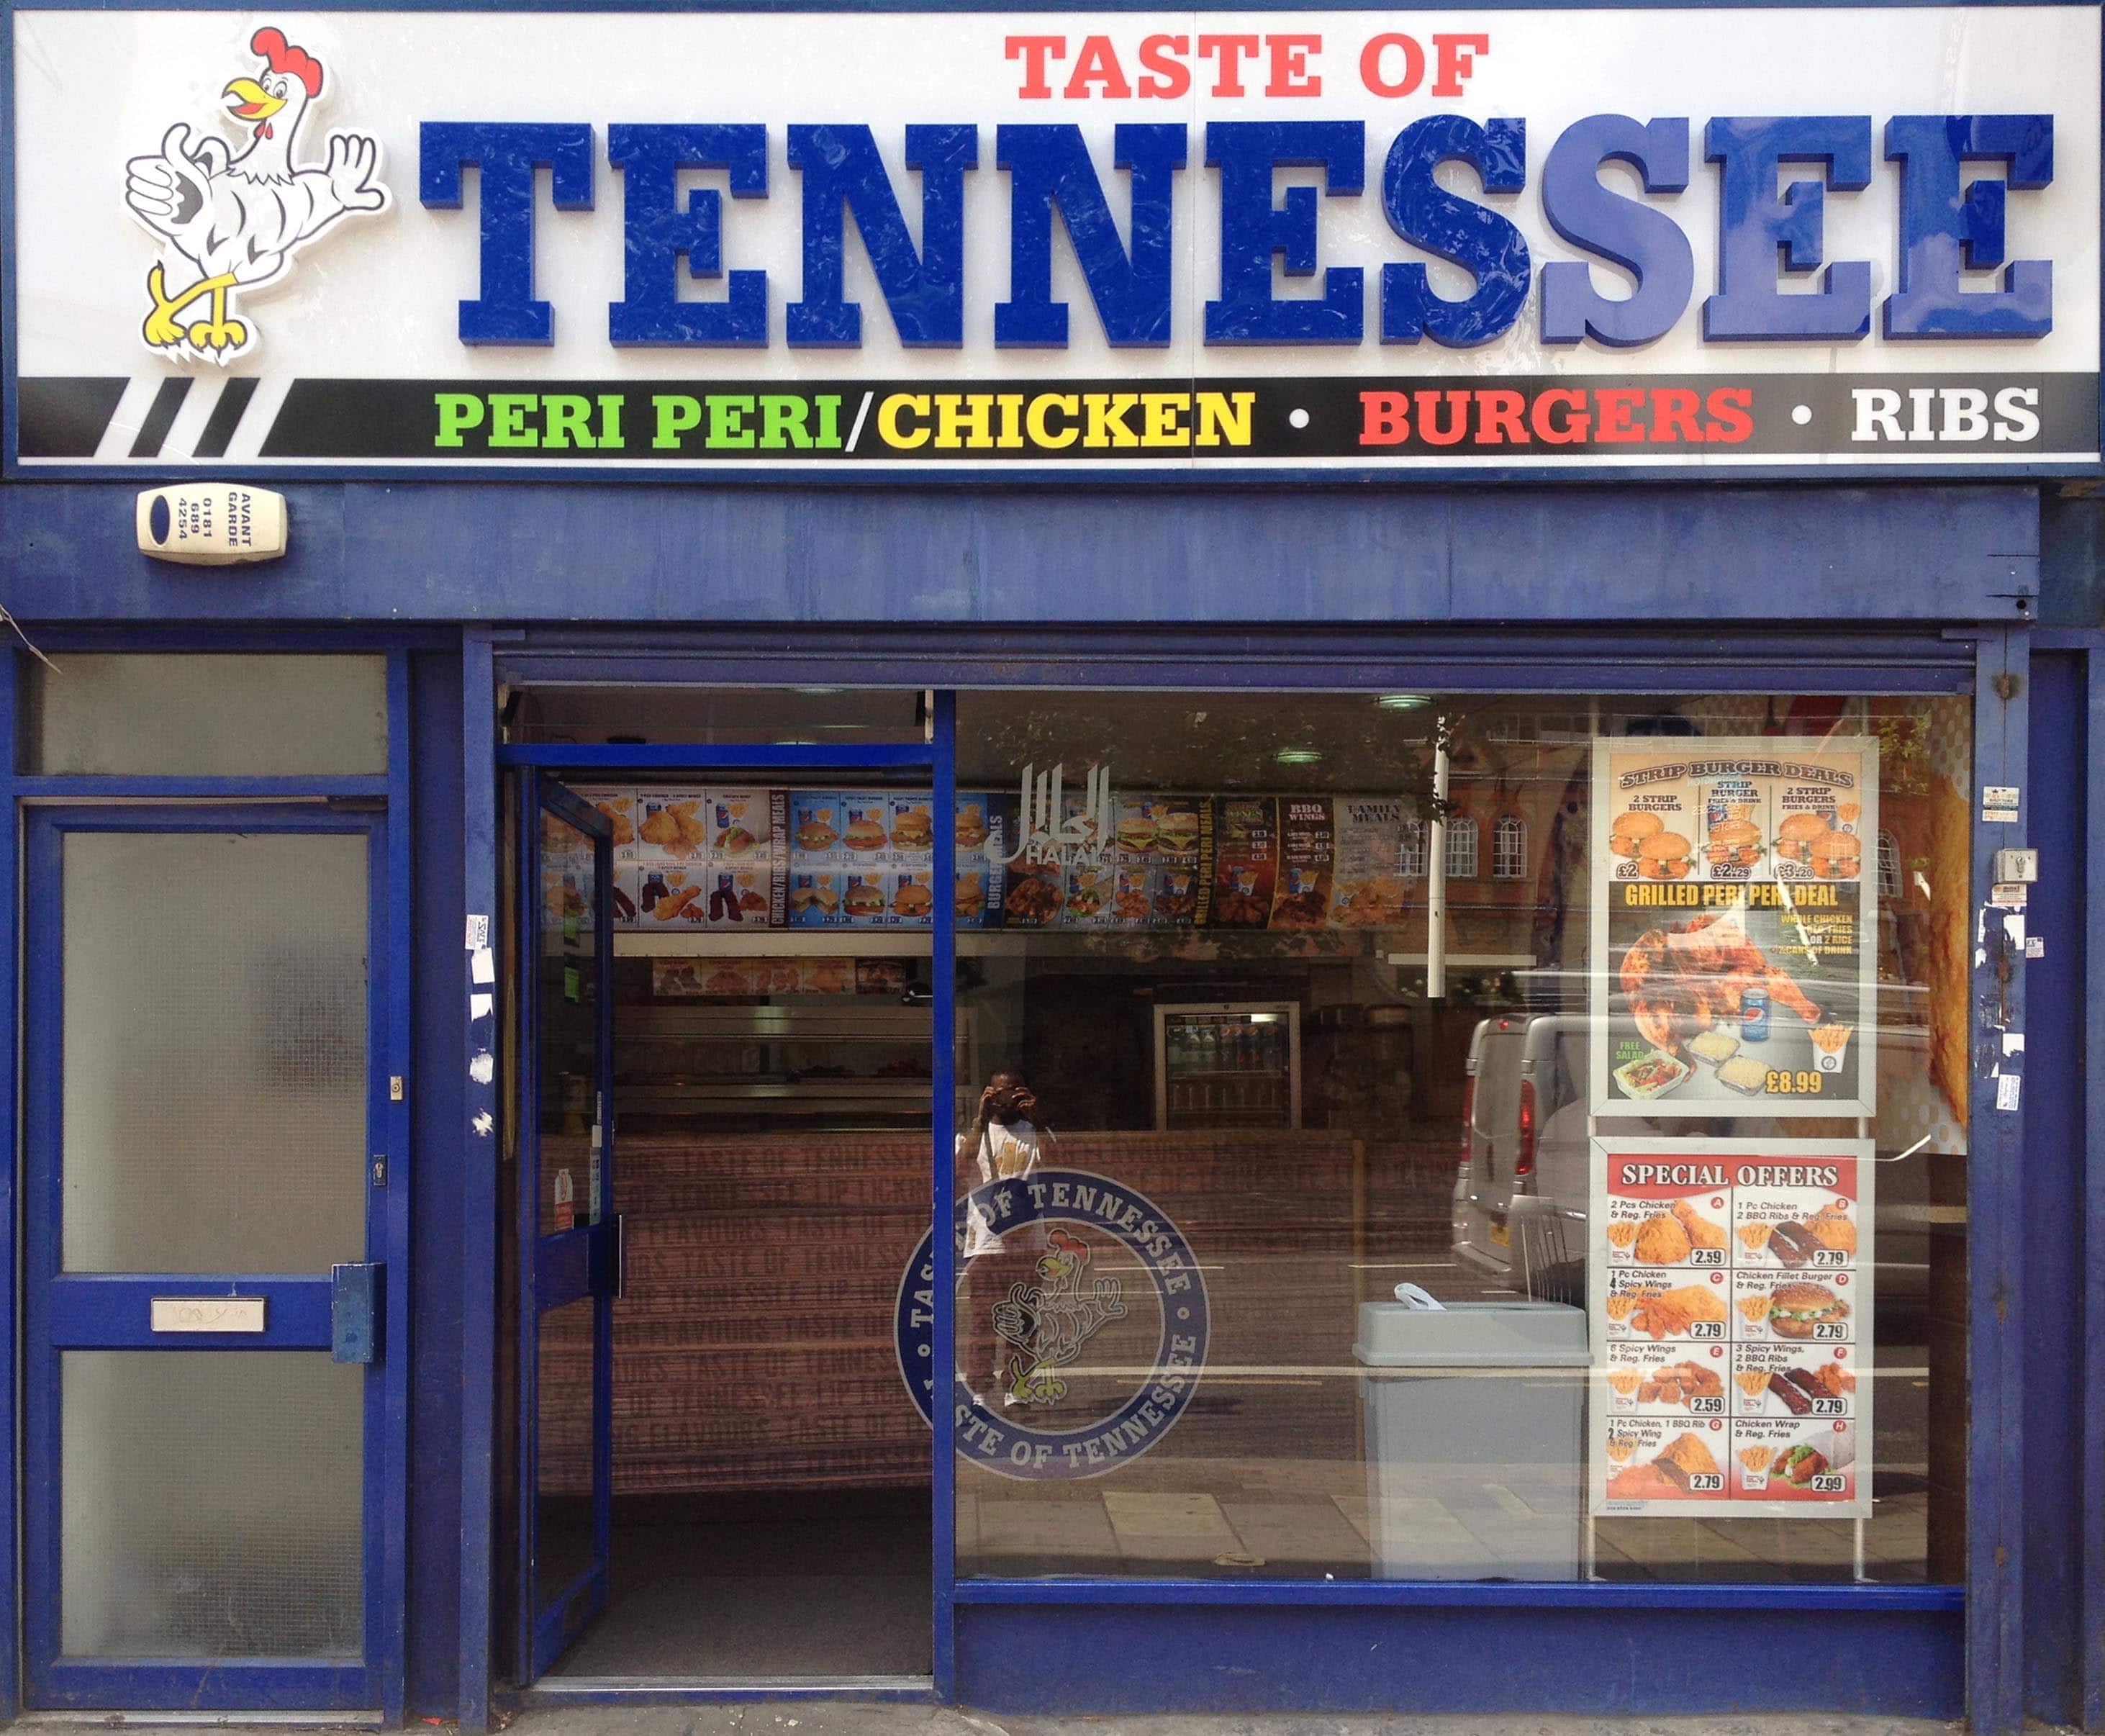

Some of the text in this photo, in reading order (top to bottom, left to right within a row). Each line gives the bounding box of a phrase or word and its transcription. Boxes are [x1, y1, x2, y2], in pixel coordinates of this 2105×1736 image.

[1005, 32, 1490, 99] TASTE OF
[420, 113, 2054, 349] TENNESSEE
[434, 393, 626, 448] PERI
[1359, 387, 1754, 446] BURGERS
[1850, 386, 2041, 442] RIBS
[178, 497, 187, 540] 4254
[191, 502, 199, 533] 689
[203, 498, 212, 538] 0181
[228, 492, 237, 546] GARDE
[242, 493, 251, 546] AVANT
[1621, 764, 1687, 788] STRIP
[1689, 761, 1782, 778] BURGER
[1784, 764, 1853, 787] DEALS
[771, 794, 786, 824] MEALS
[1290, 804, 1323, 813] BBQ
[1200, 837, 1213, 860] PERI
[1199, 864, 1212, 887] PERI
[1617, 864, 1638, 877] £2
[1626, 885, 1698, 905] GRILLED
[1795, 885, 1838, 905] DEAL
[1193, 889, 1210, 925] GRILLED
[1814, 915, 1853, 923] CHICKEN
[1810, 936, 1853, 944] OR 2 RICE
[1824, 946, 1852, 954] DRINK
[1620, 1041, 1640, 1050] FREE
[1616, 1051, 1644, 1059] SALAD
[1766, 1071, 1822, 1093] £8.99
[1621, 1164, 1839, 1186] SPECIAL OFFERS
[1639, 1201, 1675, 1209] Chicken
[1621, 1211, 1641, 1220] Reg.
[977, 1190, 1013, 1226] OF
[1028, 1182, 1191, 1295] TENNESSEE
[1695, 1251, 1721, 1263] 2.59
[1817, 1252, 1844, 1265] 2.79
[1645, 1280, 1672, 1289] Wings
[1694, 1324, 1721, 1337] 2.79
[1817, 1325, 1844, 1338] 2.79
[1619, 1344, 1644, 1353] Spicy
[1647, 1345, 1676, 1354] Wings
[1745, 1344, 1770, 1353] Spicy
[1773, 1344, 1804, 1353] Wings,
[1620, 1355, 1640, 1363] Reg.
[1010, 1441, 1053, 1469] OF
[1062, 1334, 1197, 1468] TENNESSEE
[1694, 1398, 1721, 1411] 2.59
[1816, 1400, 1842, 1413] 2.79
[1775, 1420, 1800, 1429] Wrap
[1617, 1429, 1638, 1438] Spicy
[1641, 1429, 1662, 1439] Wing
[1693, 1475, 1720, 1488] 2.79
[1815, 1477, 1842, 1491] 2.99
